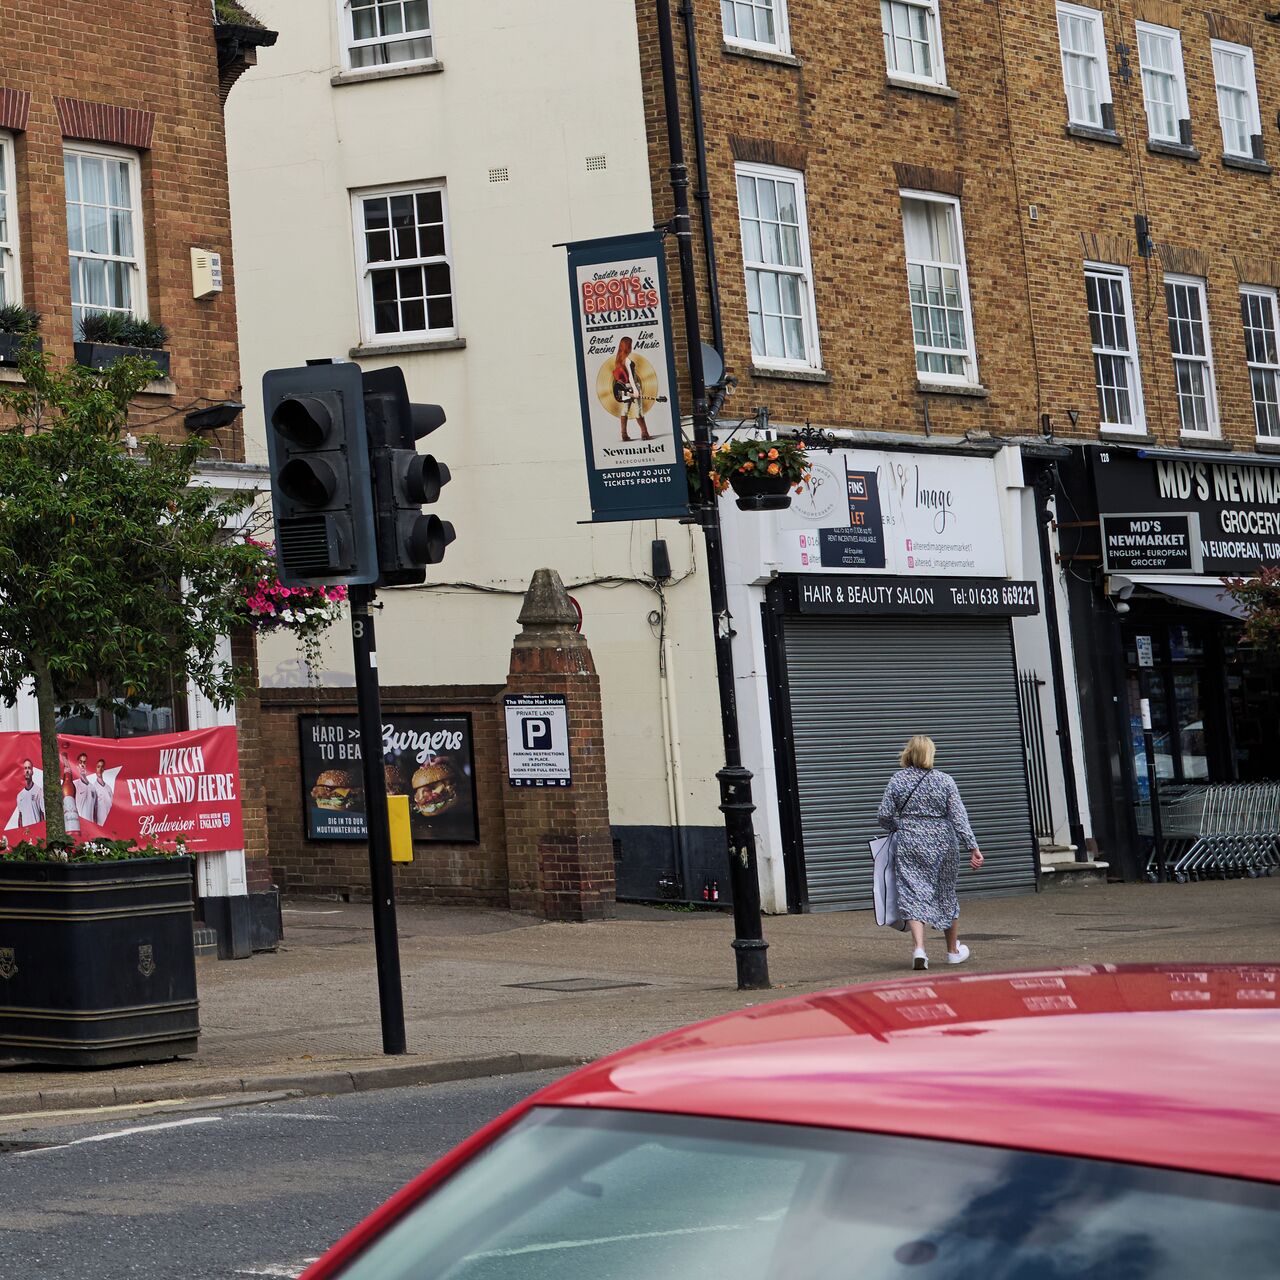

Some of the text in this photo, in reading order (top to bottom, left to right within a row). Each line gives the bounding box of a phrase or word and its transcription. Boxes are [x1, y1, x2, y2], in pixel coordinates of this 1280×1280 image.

[592, 270, 618, 281] Saddle
[620, 269, 630, 277] up
[582, 276, 654, 297] BOOTS &
[583, 290, 659, 315] BRIDLES
[585, 306, 657, 326] RACEDAY
[589, 334, 614, 345] Great
[637, 330, 654, 340] Live
[587, 345, 616, 355] Racing
[633, 339, 660, 350] Music
[602, 443, 665, 457] Newmarket
[615, 457, 656, 465] RACECOURSES
[1100, 453, 1110, 463] 128
[602, 470, 640, 479] SATURDAY
[642, 469, 651, 477] 20
[1156, 460, 1210, 501] MD'S
[603, 479, 635, 487] TICKETS
[636, 477, 658, 485] FROM
[847, 481, 864, 494] FINS
[915, 465, 957, 534] Image
[850, 511, 865, 525] LET
[1130, 521, 1162, 532] MD'S
[1109, 534, 1185, 547] NEWMARKET
[1109, 549, 1140, 557] ENGLISH
[1146, 549, 1188, 557] EUROPEAN
[1211, 541, 1264, 562] EUROPEAN,
[1130, 558, 1167, 566] GROCERY
[803, 585, 833, 603] HAIR
[836, 586, 844, 602] &
[848, 586, 892, 603] BEAUTY
[897, 587, 934, 605] SALON
[1002, 586, 1035, 605] 669221
[352, 620, 364, 638] 8
[312, 726, 344, 742] HARD
[526, 719, 546, 748] P
[381, 723, 463, 764] Burgers
[319, 744, 362, 760] TO BEA
[158, 746, 205, 775] WATCH
[126, 773, 236, 806] ENGLAND HERE
[138, 814, 195, 835] Budweiser
[200, 819, 222, 829] ENGLAND
[327, 817, 364, 825] DIG IN TO OUR
[316, 826, 360, 834] MOUTHWATERING
